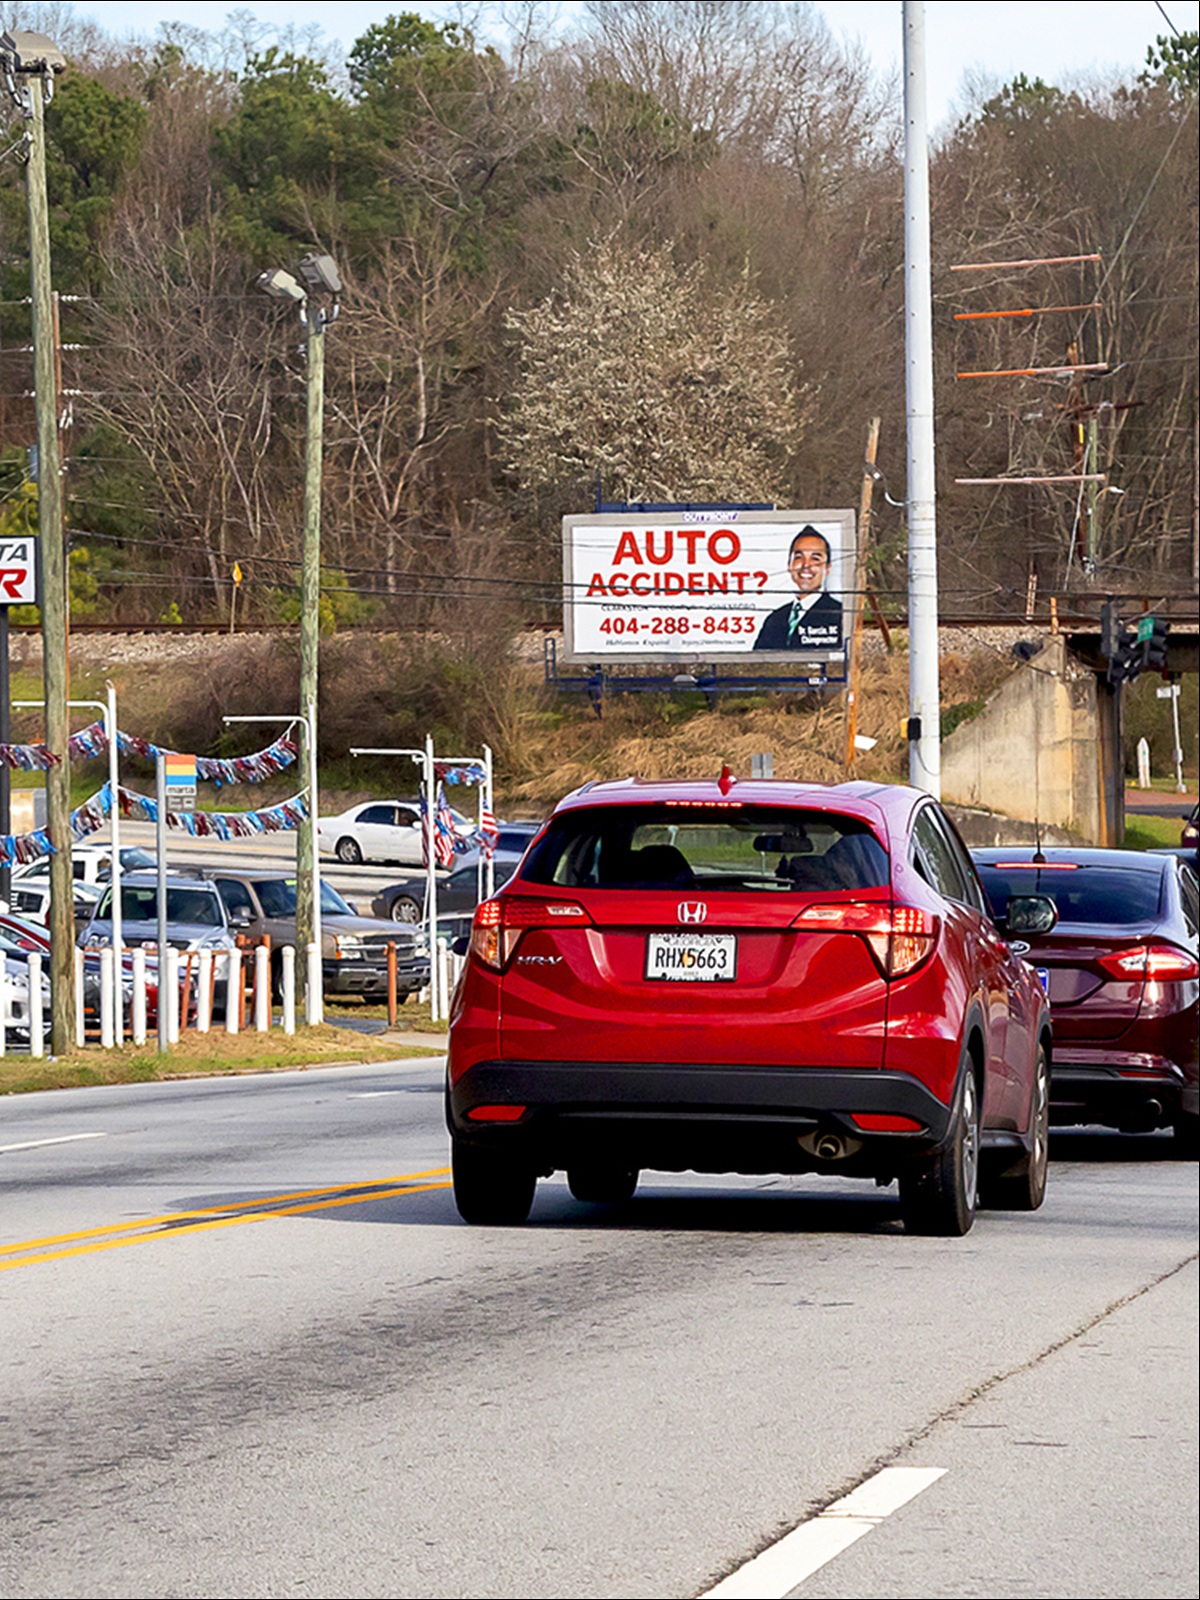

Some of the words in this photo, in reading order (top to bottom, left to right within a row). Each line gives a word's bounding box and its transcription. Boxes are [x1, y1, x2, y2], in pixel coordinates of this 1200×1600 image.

[612, 530, 741, 566] AUTO
[586, 571, 768, 597] ACCIDENT?
[599, 616, 756, 635] 404-288-8433
[167, 786, 195, 794] marta
[516, 955, 564, 966] HR-V
[654, 946, 728, 969] RHX5663
